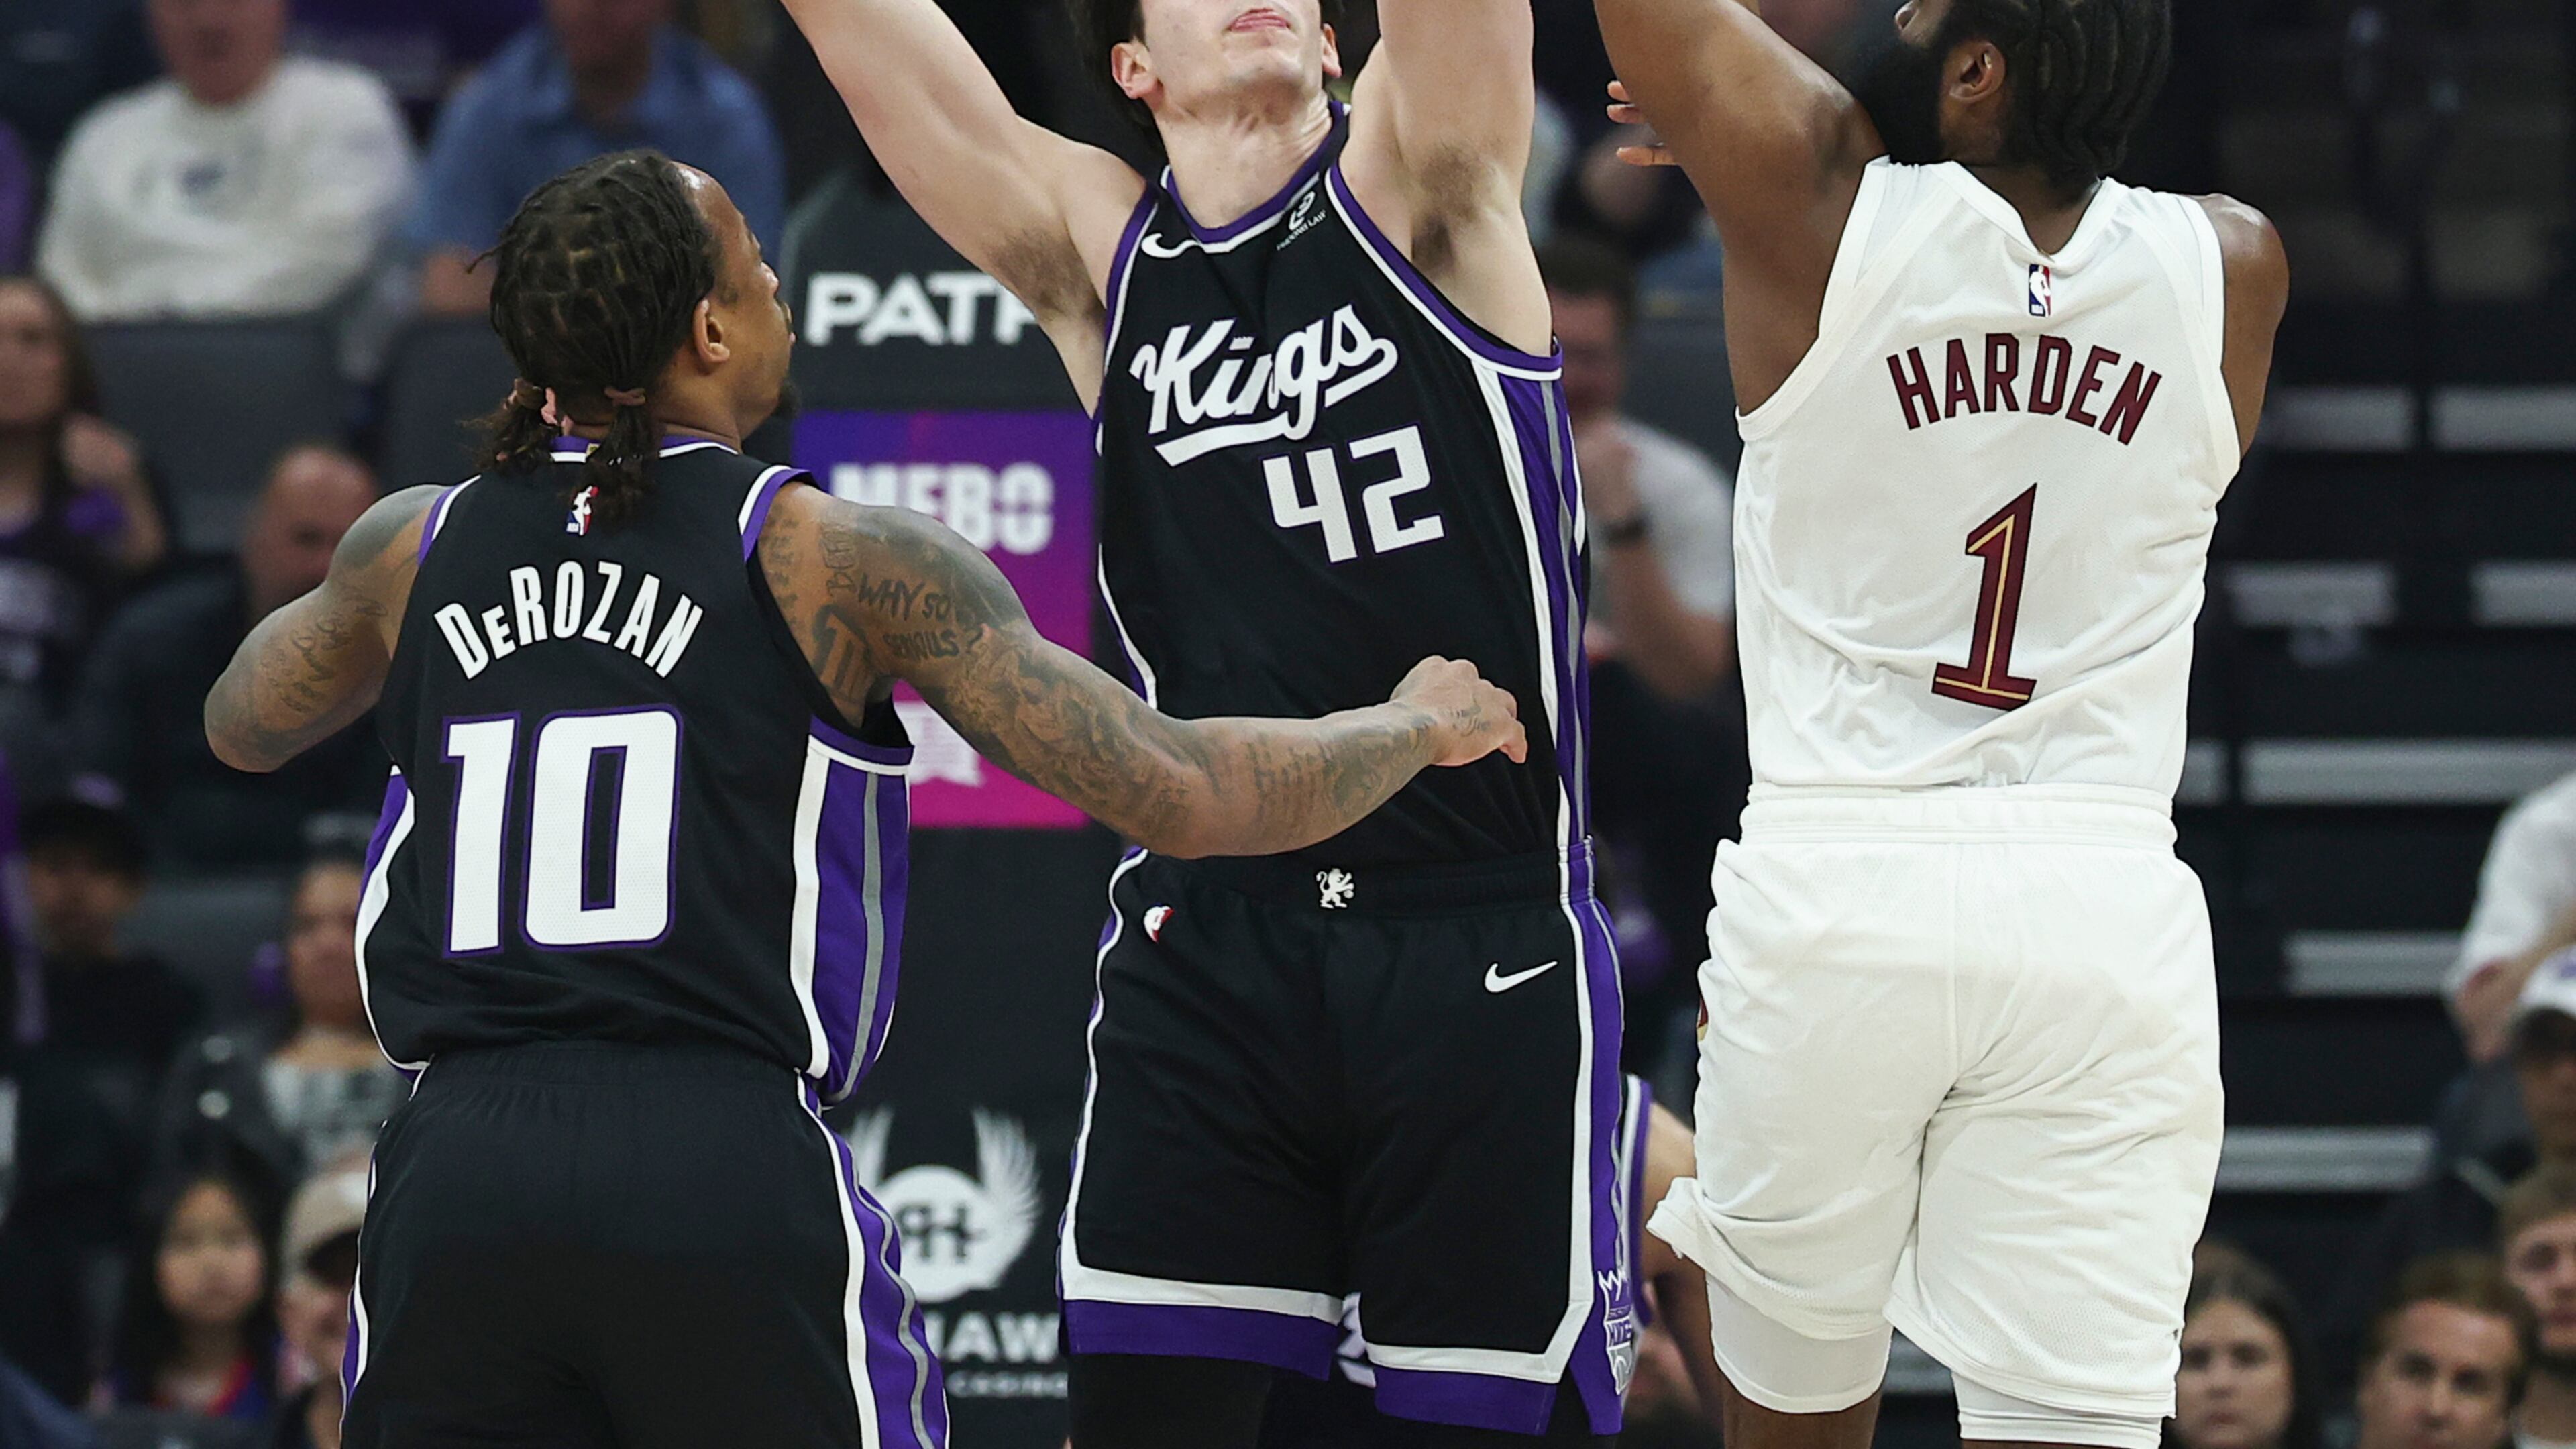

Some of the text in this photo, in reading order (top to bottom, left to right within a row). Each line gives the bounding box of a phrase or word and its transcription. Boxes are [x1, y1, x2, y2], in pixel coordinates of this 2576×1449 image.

[1130, 303, 1398, 467] Kings
[1886, 332, 2163, 446] HARDEN
[1262, 423, 1445, 564] 42
[433, 560, 704, 680] DeROZAN
[857, 572, 950, 622] WHY SO
[1931, 482, 2038, 712] 1
[441, 703, 683, 957] 10
